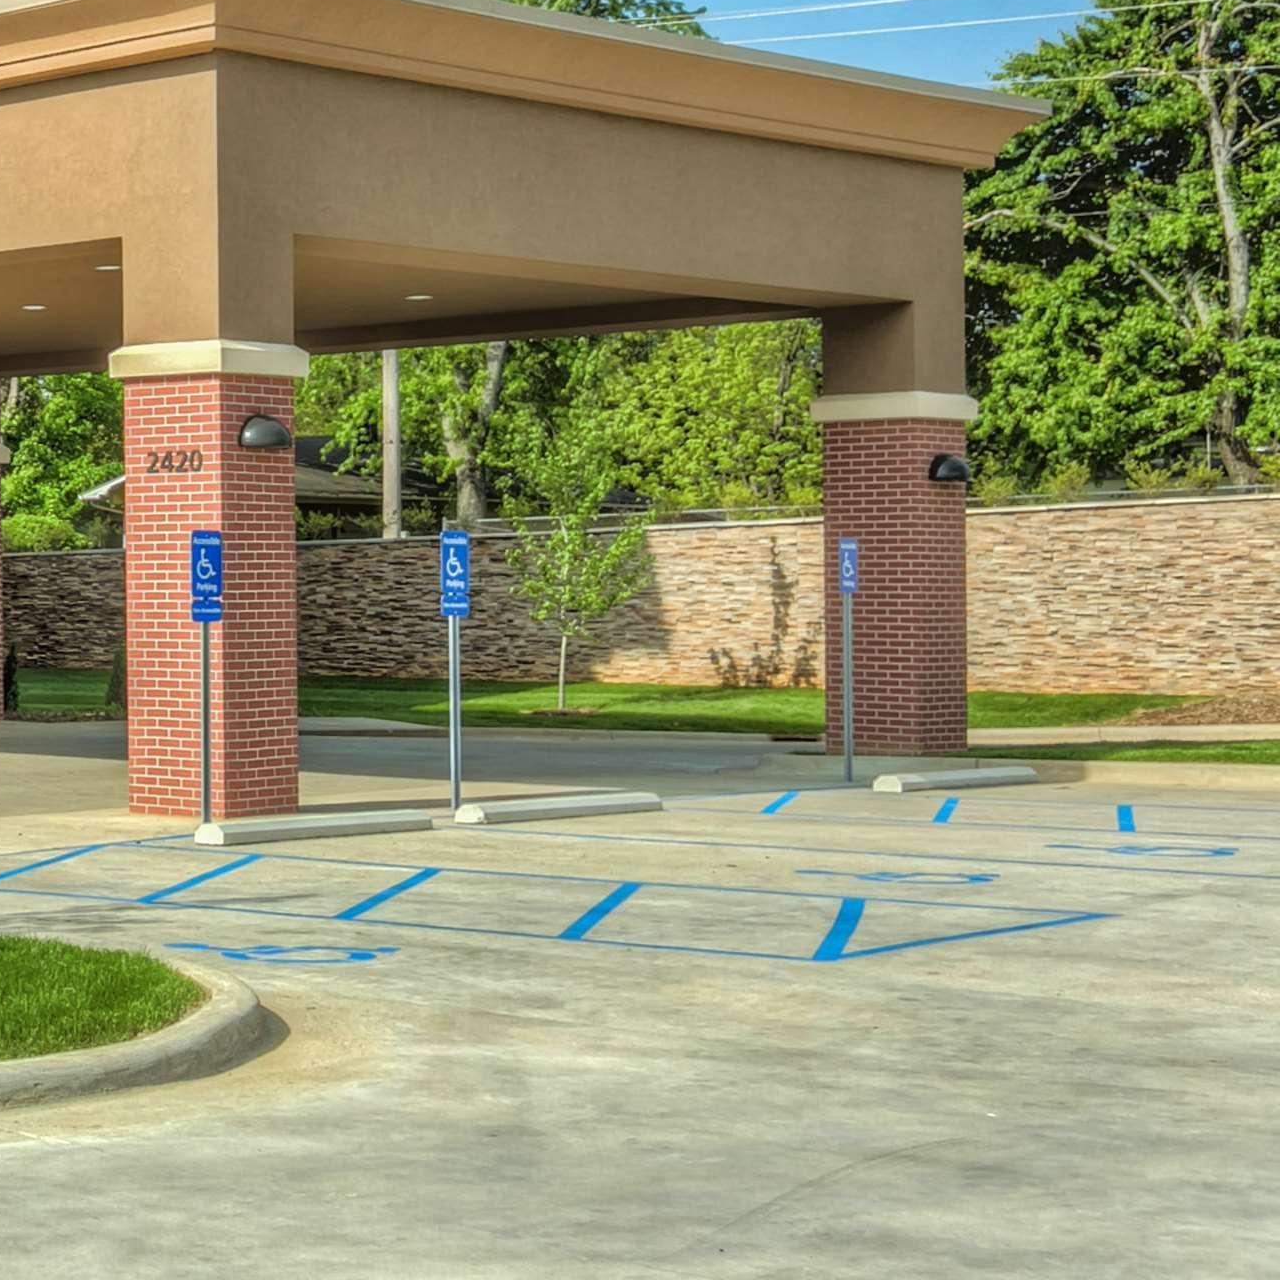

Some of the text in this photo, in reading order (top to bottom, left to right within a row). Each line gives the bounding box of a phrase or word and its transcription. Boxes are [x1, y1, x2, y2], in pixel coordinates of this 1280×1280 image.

[145, 449, 204, 474] 2420
[192, 535, 221, 545] Accessible
[195, 582, 218, 593] Parking
